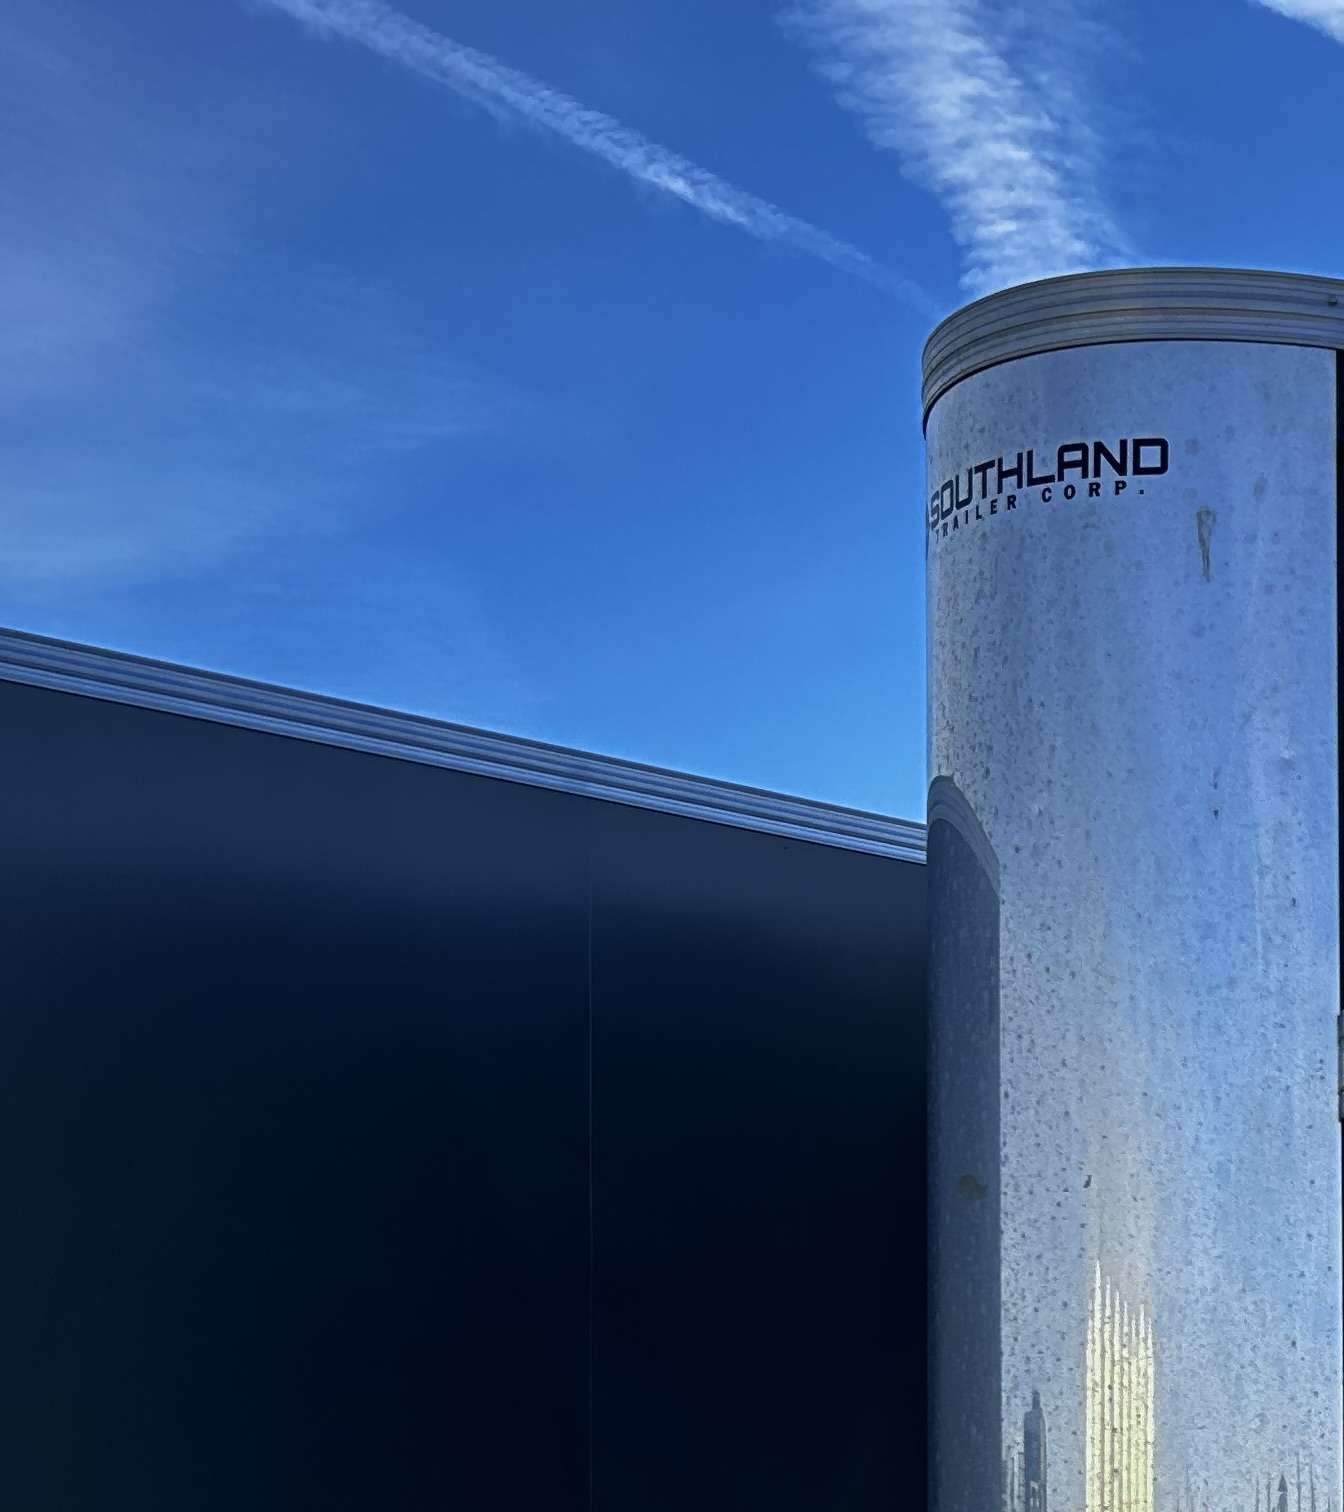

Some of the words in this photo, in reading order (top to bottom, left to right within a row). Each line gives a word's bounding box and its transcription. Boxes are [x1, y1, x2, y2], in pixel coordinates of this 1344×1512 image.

[930, 438, 1169, 531] SOUTHLAND
[935, 494, 1017, 543] TRAILER
[1041, 480, 1145, 503] CORP.
